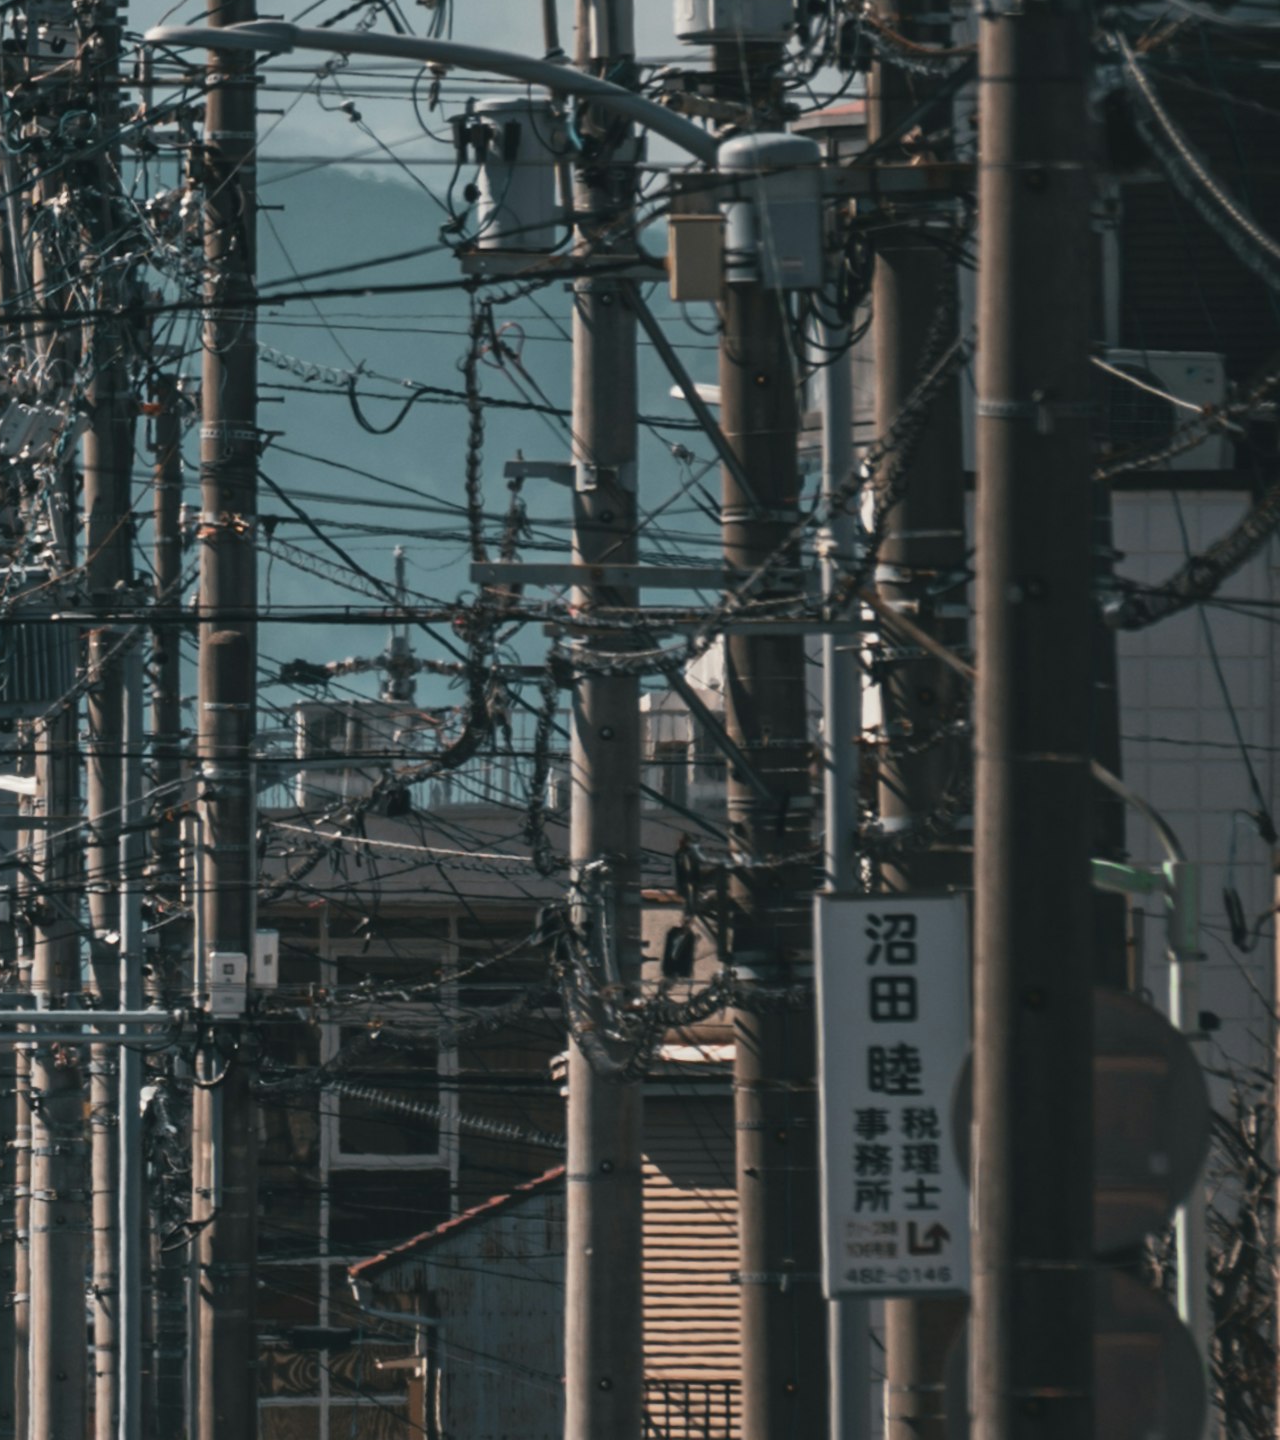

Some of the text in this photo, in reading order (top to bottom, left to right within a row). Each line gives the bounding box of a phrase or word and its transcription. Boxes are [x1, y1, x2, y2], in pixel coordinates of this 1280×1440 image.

[852, 1107, 893, 1213] 事務所
[901, 1107, 942, 1212] 税理士
